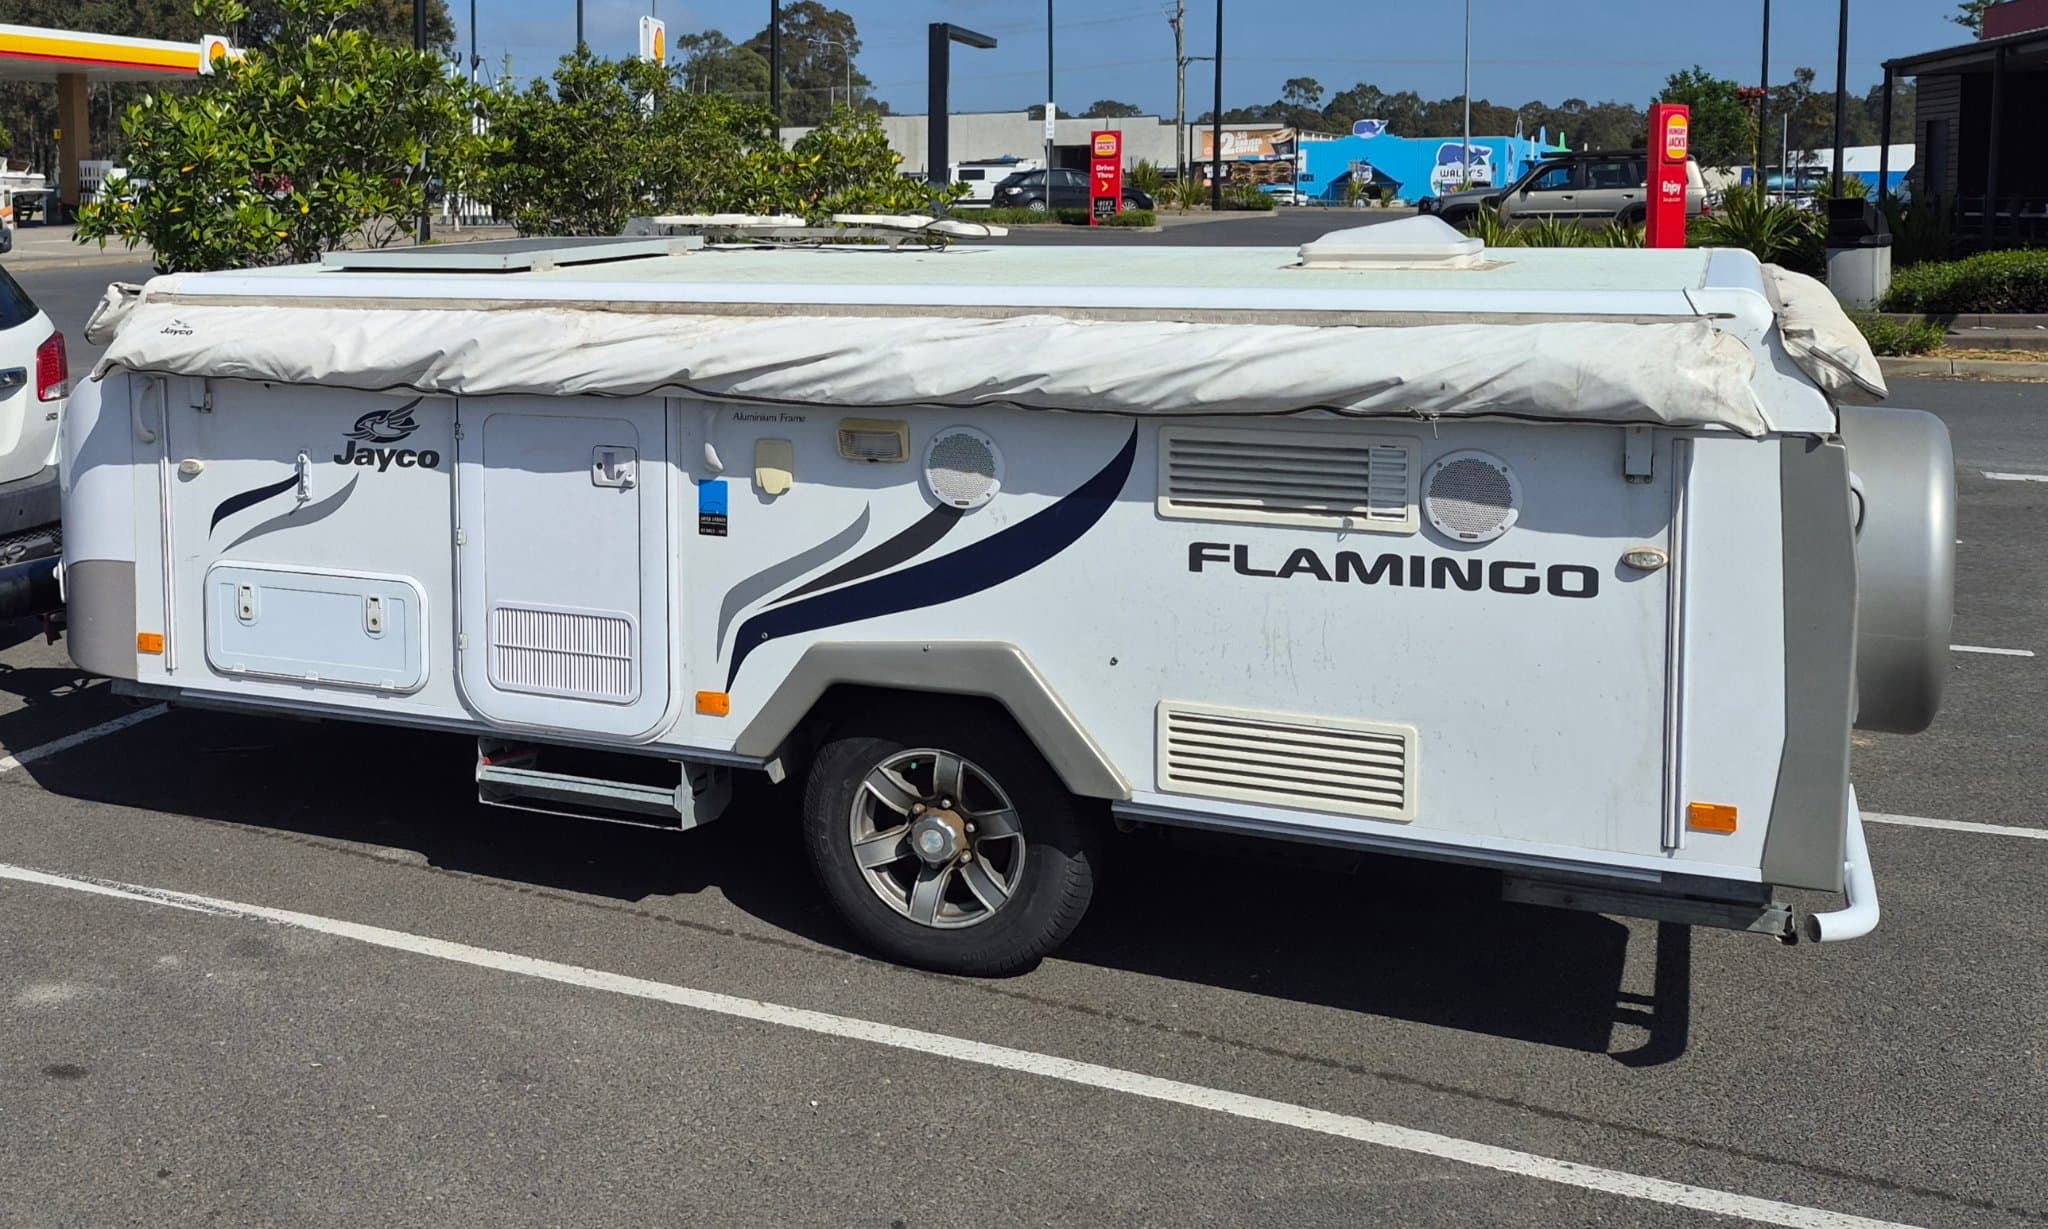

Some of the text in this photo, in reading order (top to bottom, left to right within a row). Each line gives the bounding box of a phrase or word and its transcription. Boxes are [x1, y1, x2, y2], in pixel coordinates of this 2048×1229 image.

[1221, 132, 1235, 155] 2
[1662, 180, 1681, 196] Enjoy
[160, 327, 193, 336] Jayco
[733, 411, 805, 422] Aluminium Frame
[333, 440, 440, 473] Jayco
[1188, 541, 1600, 599] FLAMINGO
